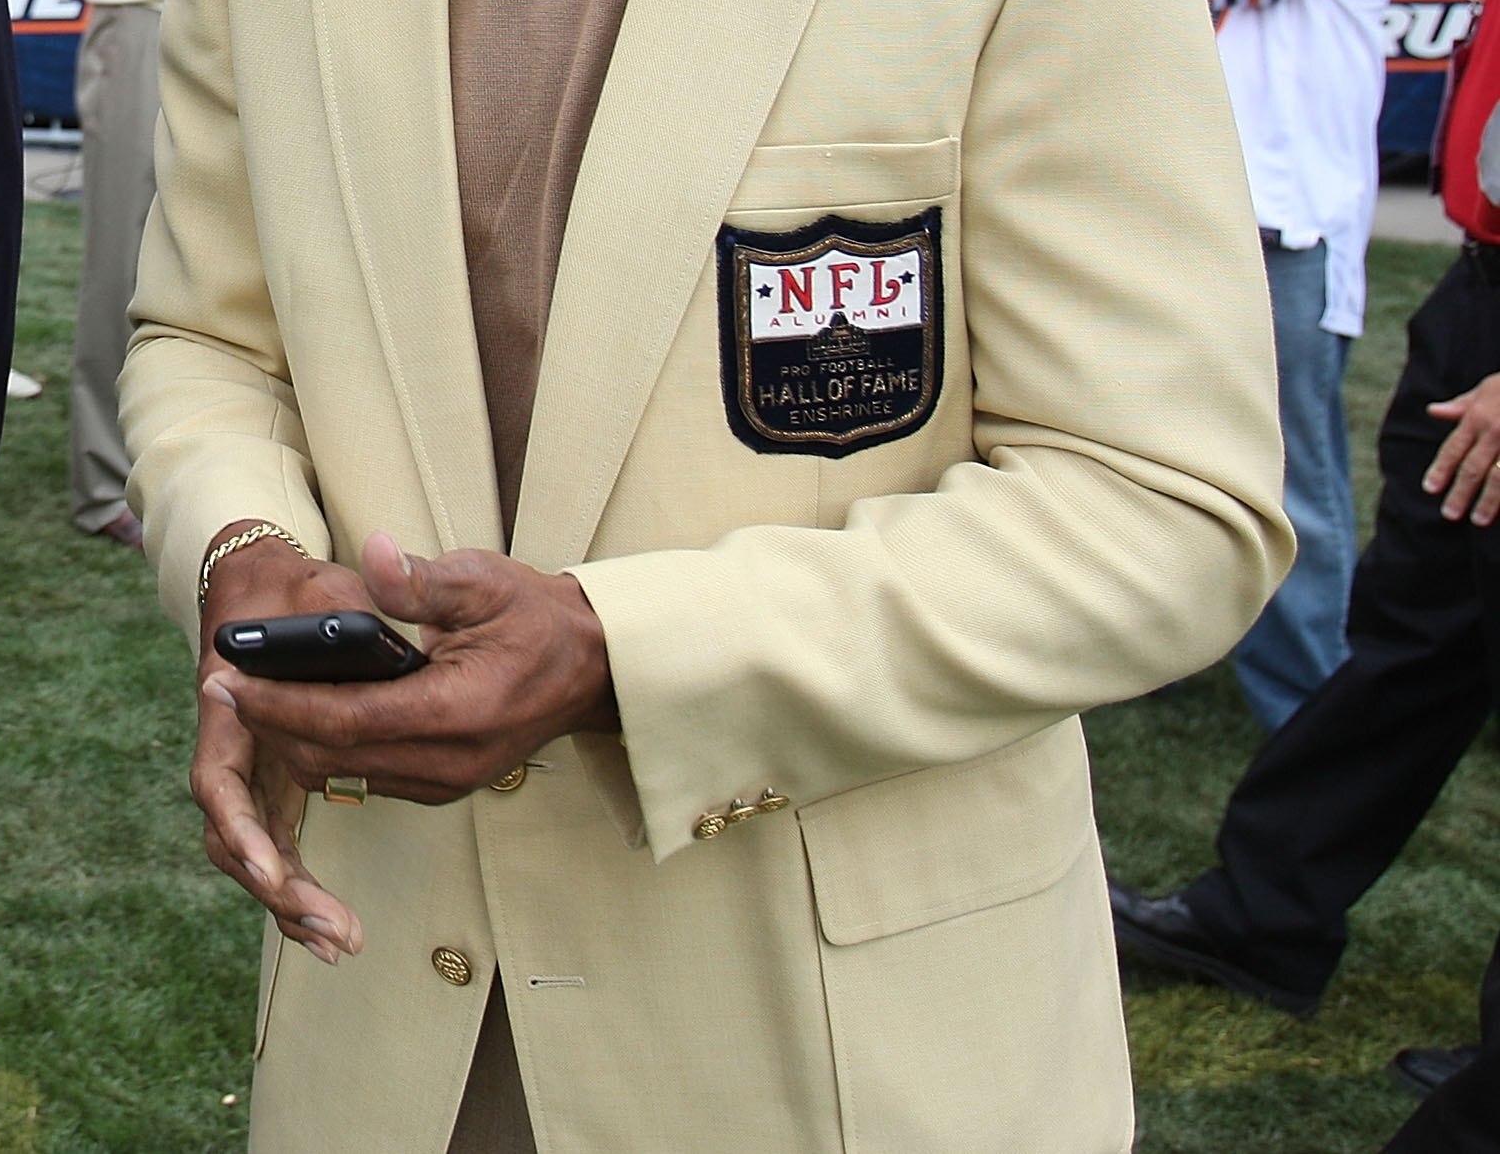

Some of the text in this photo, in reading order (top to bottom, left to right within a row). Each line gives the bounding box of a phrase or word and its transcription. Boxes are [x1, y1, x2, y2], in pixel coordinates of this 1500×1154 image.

[778, 260, 901, 314] NFL
[769, 306, 908, 328] ALUMNI
[780, 357, 895, 377] PRO FOOTBALL
[758, 368, 920, 408] HALL OF FAME
[790, 399, 893, 425] ENSHRINEE
